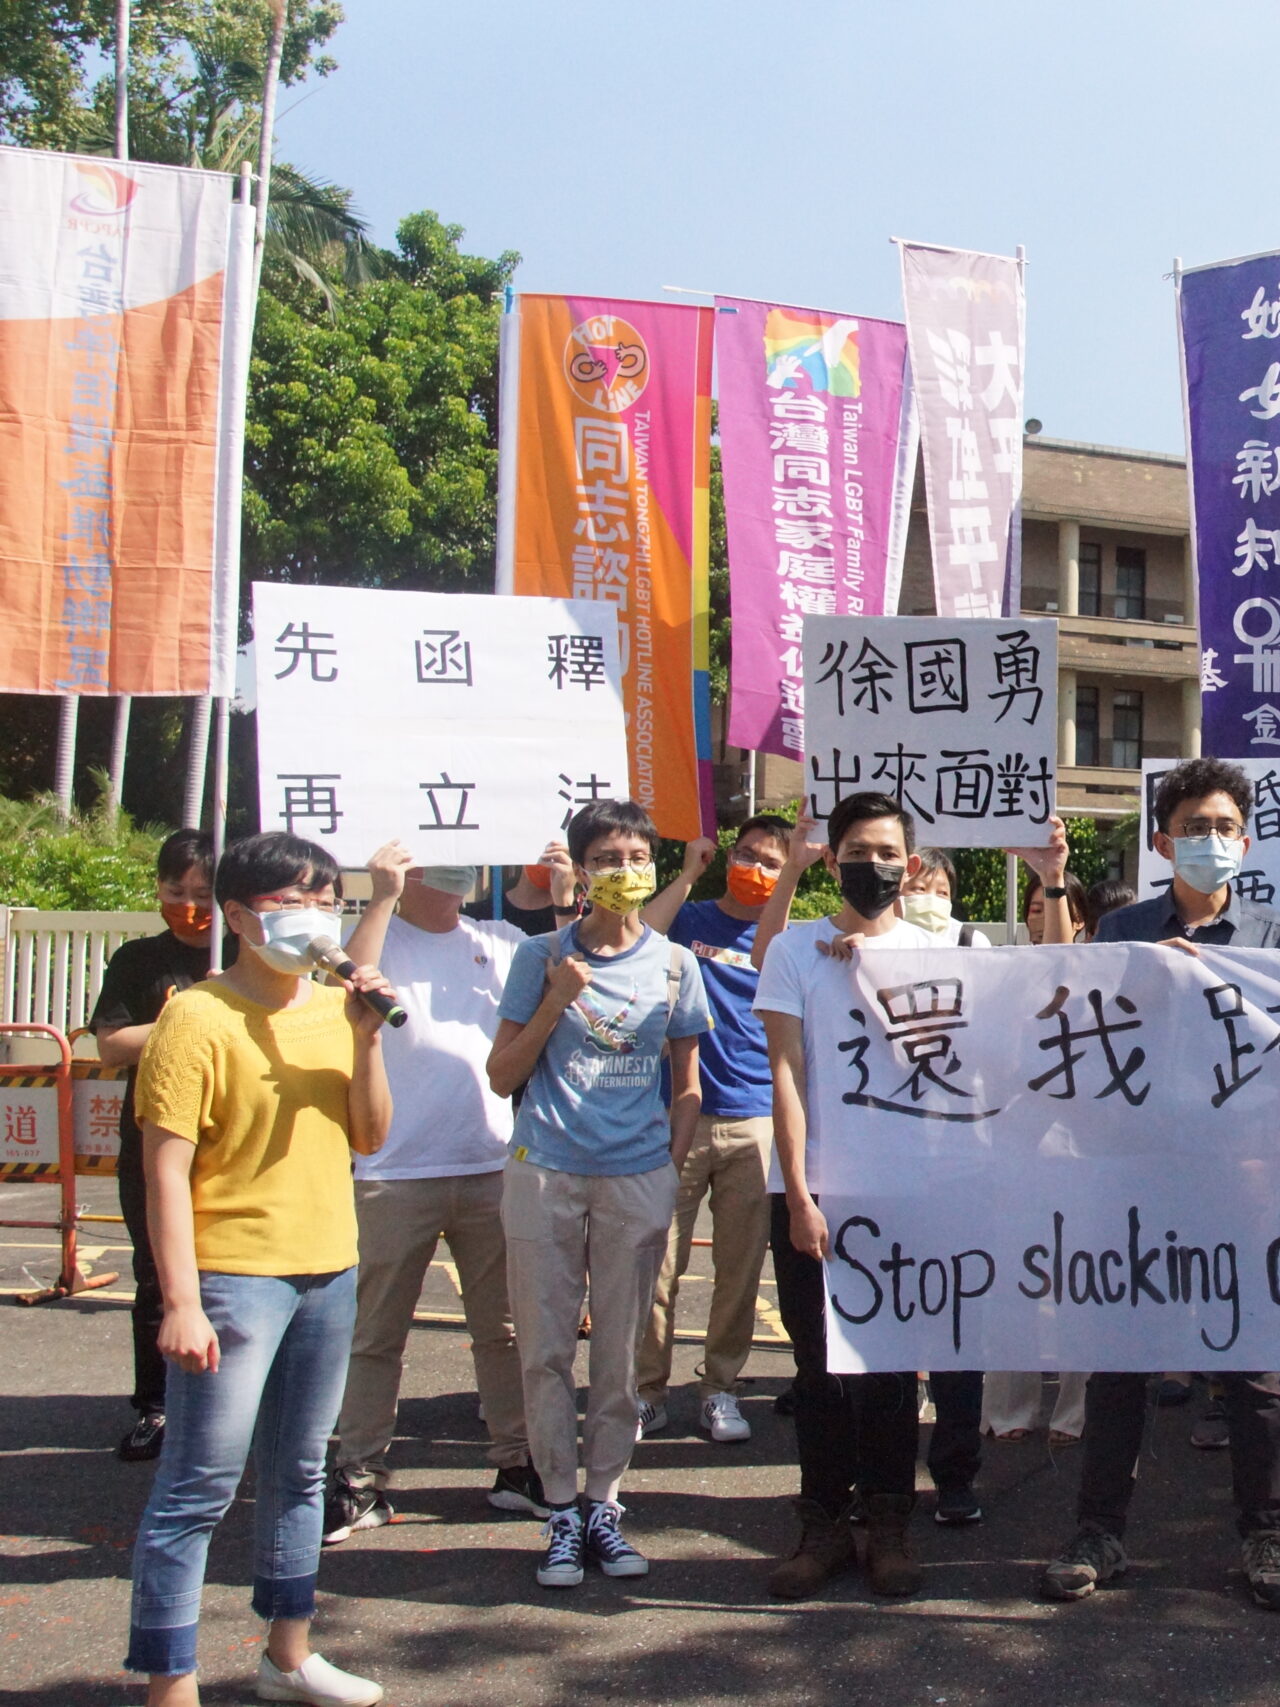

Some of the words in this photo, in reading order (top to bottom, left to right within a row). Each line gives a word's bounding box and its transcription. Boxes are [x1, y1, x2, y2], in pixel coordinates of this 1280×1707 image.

[572, 315, 616, 345] HOT
[634, 410, 650, 480] TAIWAN
[843, 402, 862, 464] Taiwan
[635, 484, 652, 563] TONGZHI
[844, 470, 863, 525] LGBT
[635, 566, 652, 613] LGBT
[843, 527, 864, 591] Family
[274, 622, 606, 691] 先函釋
[636, 615, 653, 693] HOTLINE
[816, 629, 1043, 725] 徐國勇
[636, 695, 655, 810] ASSOCIATION
[588, 1055, 658, 1074] AMNESTY
[4, 1103, 39, 1145] 道
[89, 1094, 122, 1138] 禁
[831, 1215, 996, 1355] Stop
[1019, 1206, 1241, 1352] slacking
